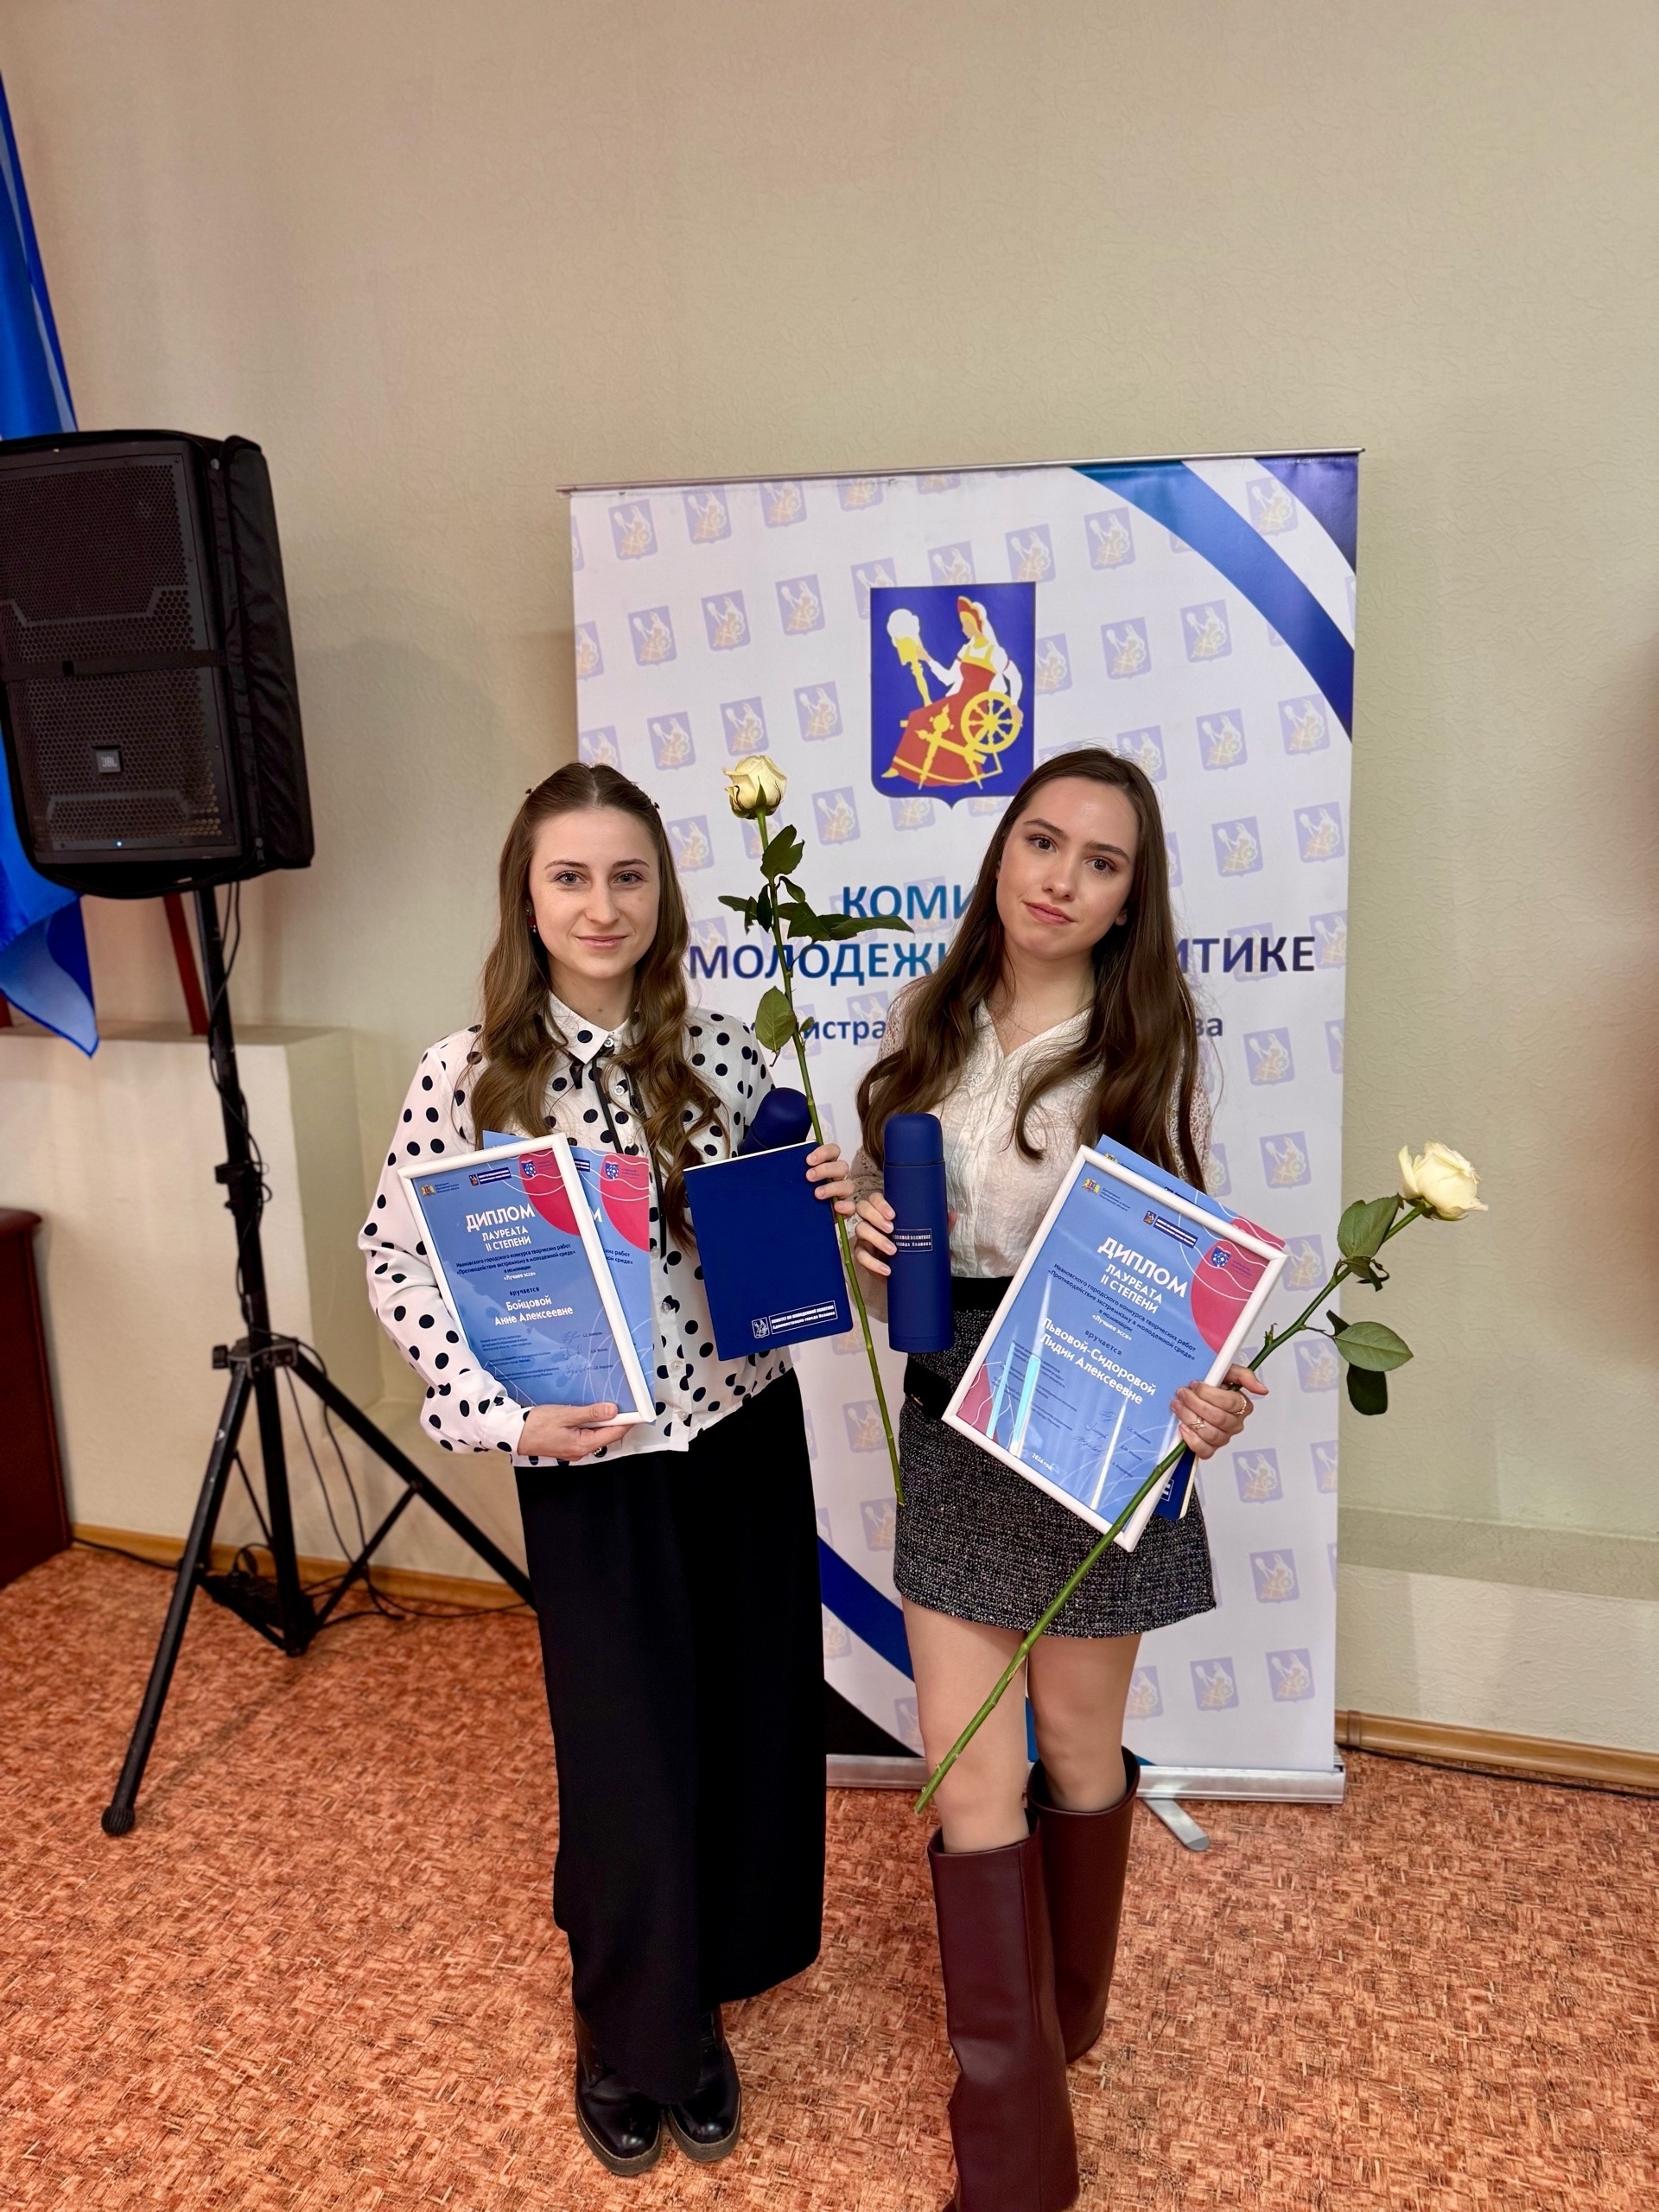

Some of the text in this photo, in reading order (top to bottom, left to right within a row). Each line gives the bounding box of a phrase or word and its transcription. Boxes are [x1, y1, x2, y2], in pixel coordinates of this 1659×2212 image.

[101, 756, 118, 768] JBL
[842, 885, 976, 920] КОМИ
[690, 936, 1315, 986] МОЛОДЕЖ ТИКЕ
[466, 1203, 536, 1233] ДИПЛОМ
[482, 1225, 528, 1242] ЛАУРЕАТА
[493, 1236, 531, 1250] СТЕПЕНИ
[1097, 1236, 1188, 1299] ДИПЛОМ
[1105, 1263, 1162, 1304] ЛАУРЕАТА
[505, 1295, 552, 1312] Бойцовой
[1109, 1280, 1159, 1314] СТЕПЕНИ
[494, 1306, 574, 1326] Анне Алексеевне
[1087, 1284, 1119, 1306] городского
[1119, 1303, 1146, 1322] конкурса
[1177, 1338, 1197, 1351] работ
[1084, 1330, 1122, 1356] вручается
[1136, 1323, 1174, 1348] молодежной
[1039, 1333, 1076, 1361] Лидии
[1075, 1357, 1143, 1405] Алексеевне
[1040, 1317, 1157, 1396] Львовой-Сидоровой
